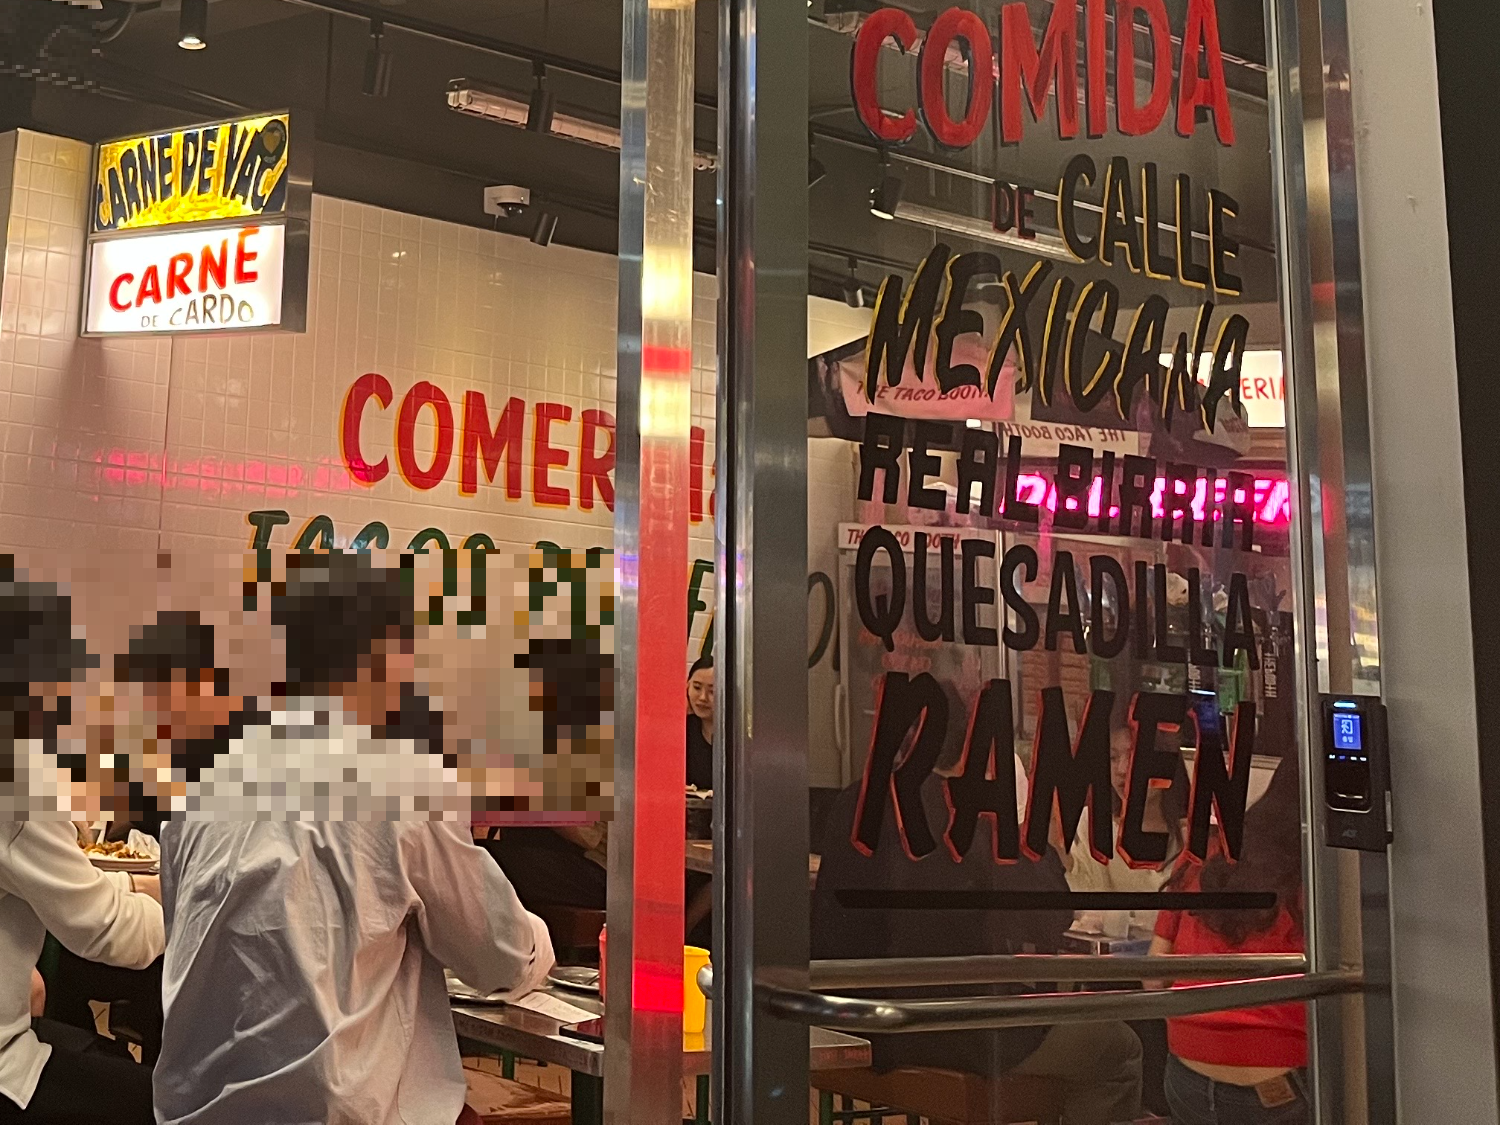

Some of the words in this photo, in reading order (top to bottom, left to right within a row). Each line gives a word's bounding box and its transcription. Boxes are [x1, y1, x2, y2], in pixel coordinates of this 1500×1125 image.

[181, 127, 219, 197] DE
[109, 224, 260, 312] CARNE
[992, 180, 1036, 239] DE
[1057, 154, 1243, 297] CALLE
[141, 315, 159, 328] DE
[169, 293, 255, 326] CARDO
[864, 242, 1251, 435] MEXICANA
[894, 387, 936, 401] TACO
[857, 411, 1040, 522] REAL
[854, 525, 1259, 671] QUESADILLA
[851, 671, 1257, 871] RAMEN
